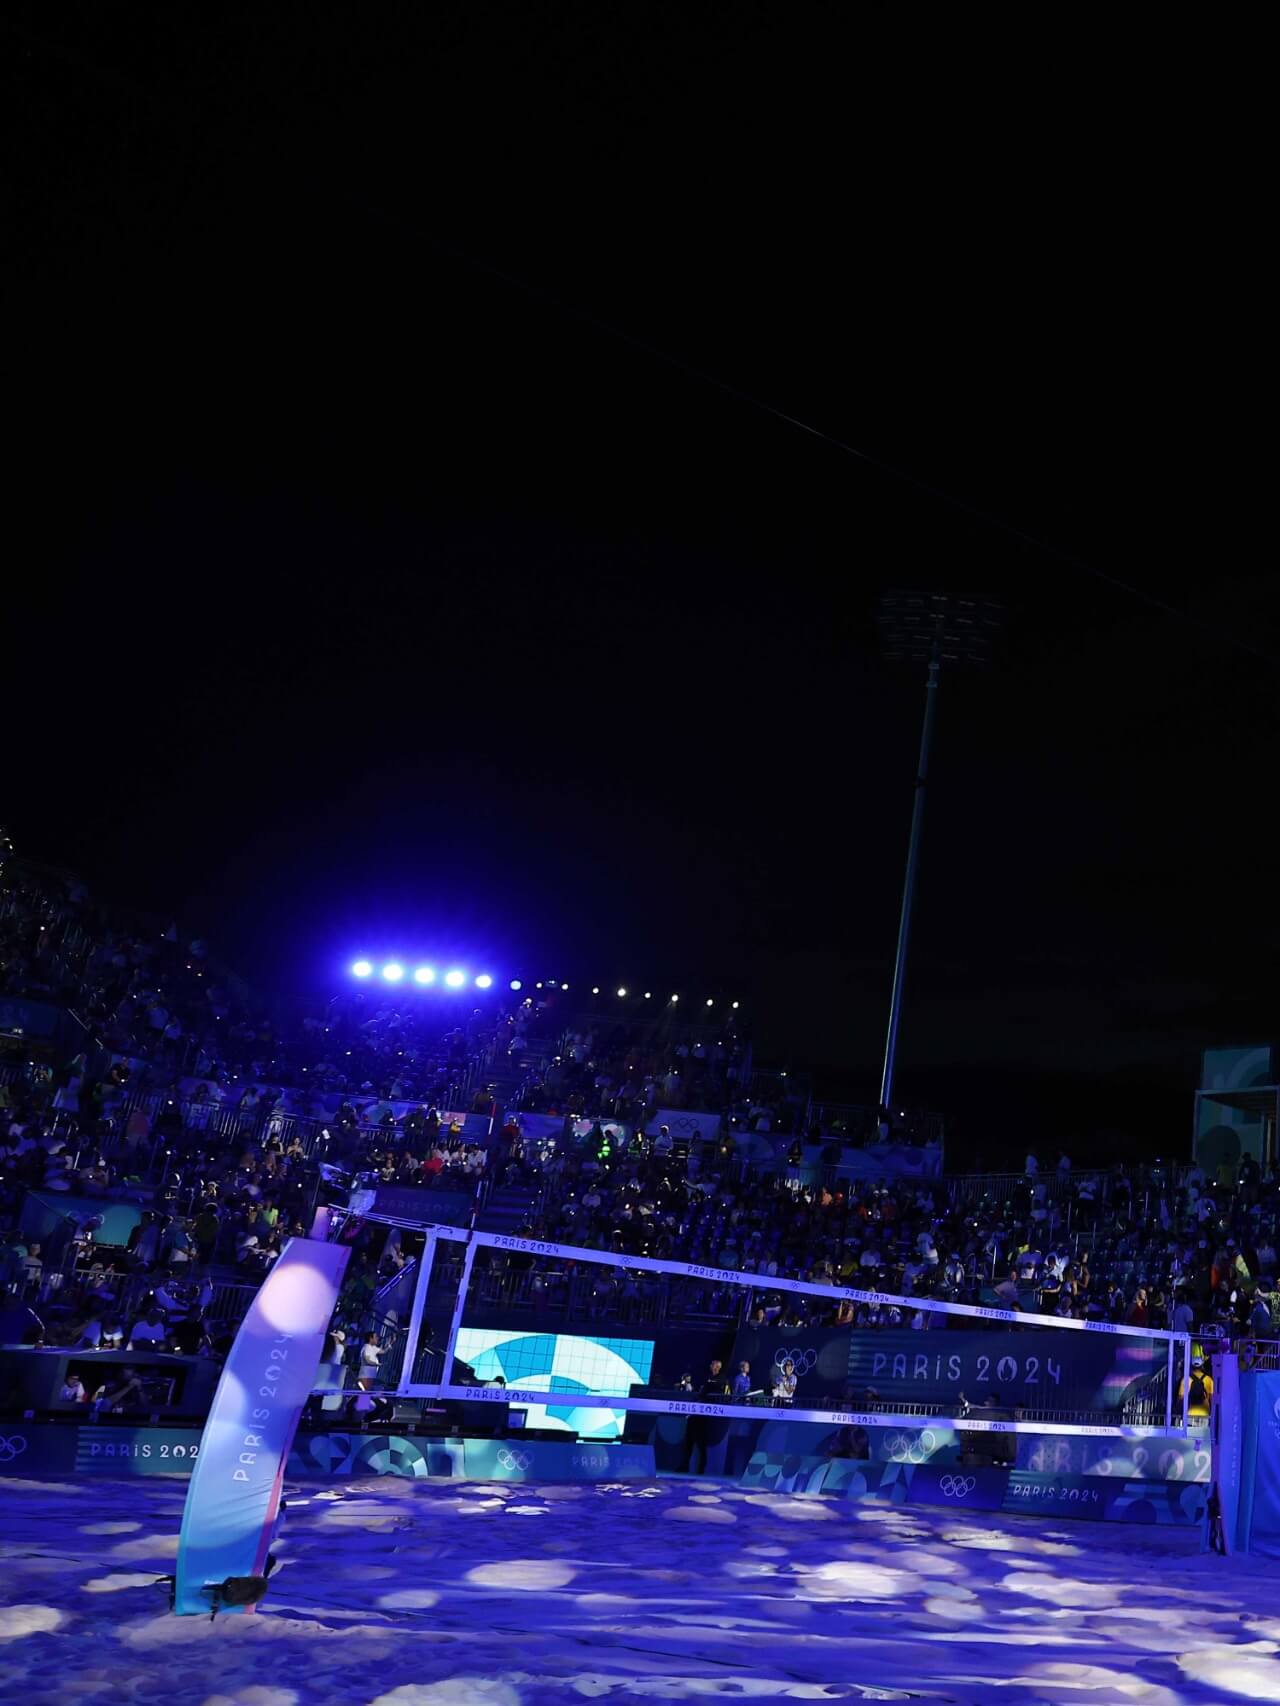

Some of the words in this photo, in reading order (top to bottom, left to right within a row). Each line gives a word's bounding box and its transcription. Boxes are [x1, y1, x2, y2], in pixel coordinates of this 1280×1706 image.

[530, 1242, 559, 1254] 2024
[716, 1270, 739, 1281] 2024
[872, 1353, 961, 1382] PARiS
[976, 1355, 1061, 1384] 2024
[504, 1391, 535, 1401] 2024
[232, 1408, 270, 1482] PARIS
[259, 1333, 294, 1397] 2024
[700, 1405, 724, 1415] 2024
[160, 1444, 200, 1458] 202
[1131, 1447, 1211, 1483] 202
[1060, 1488, 1099, 1503] 2024
